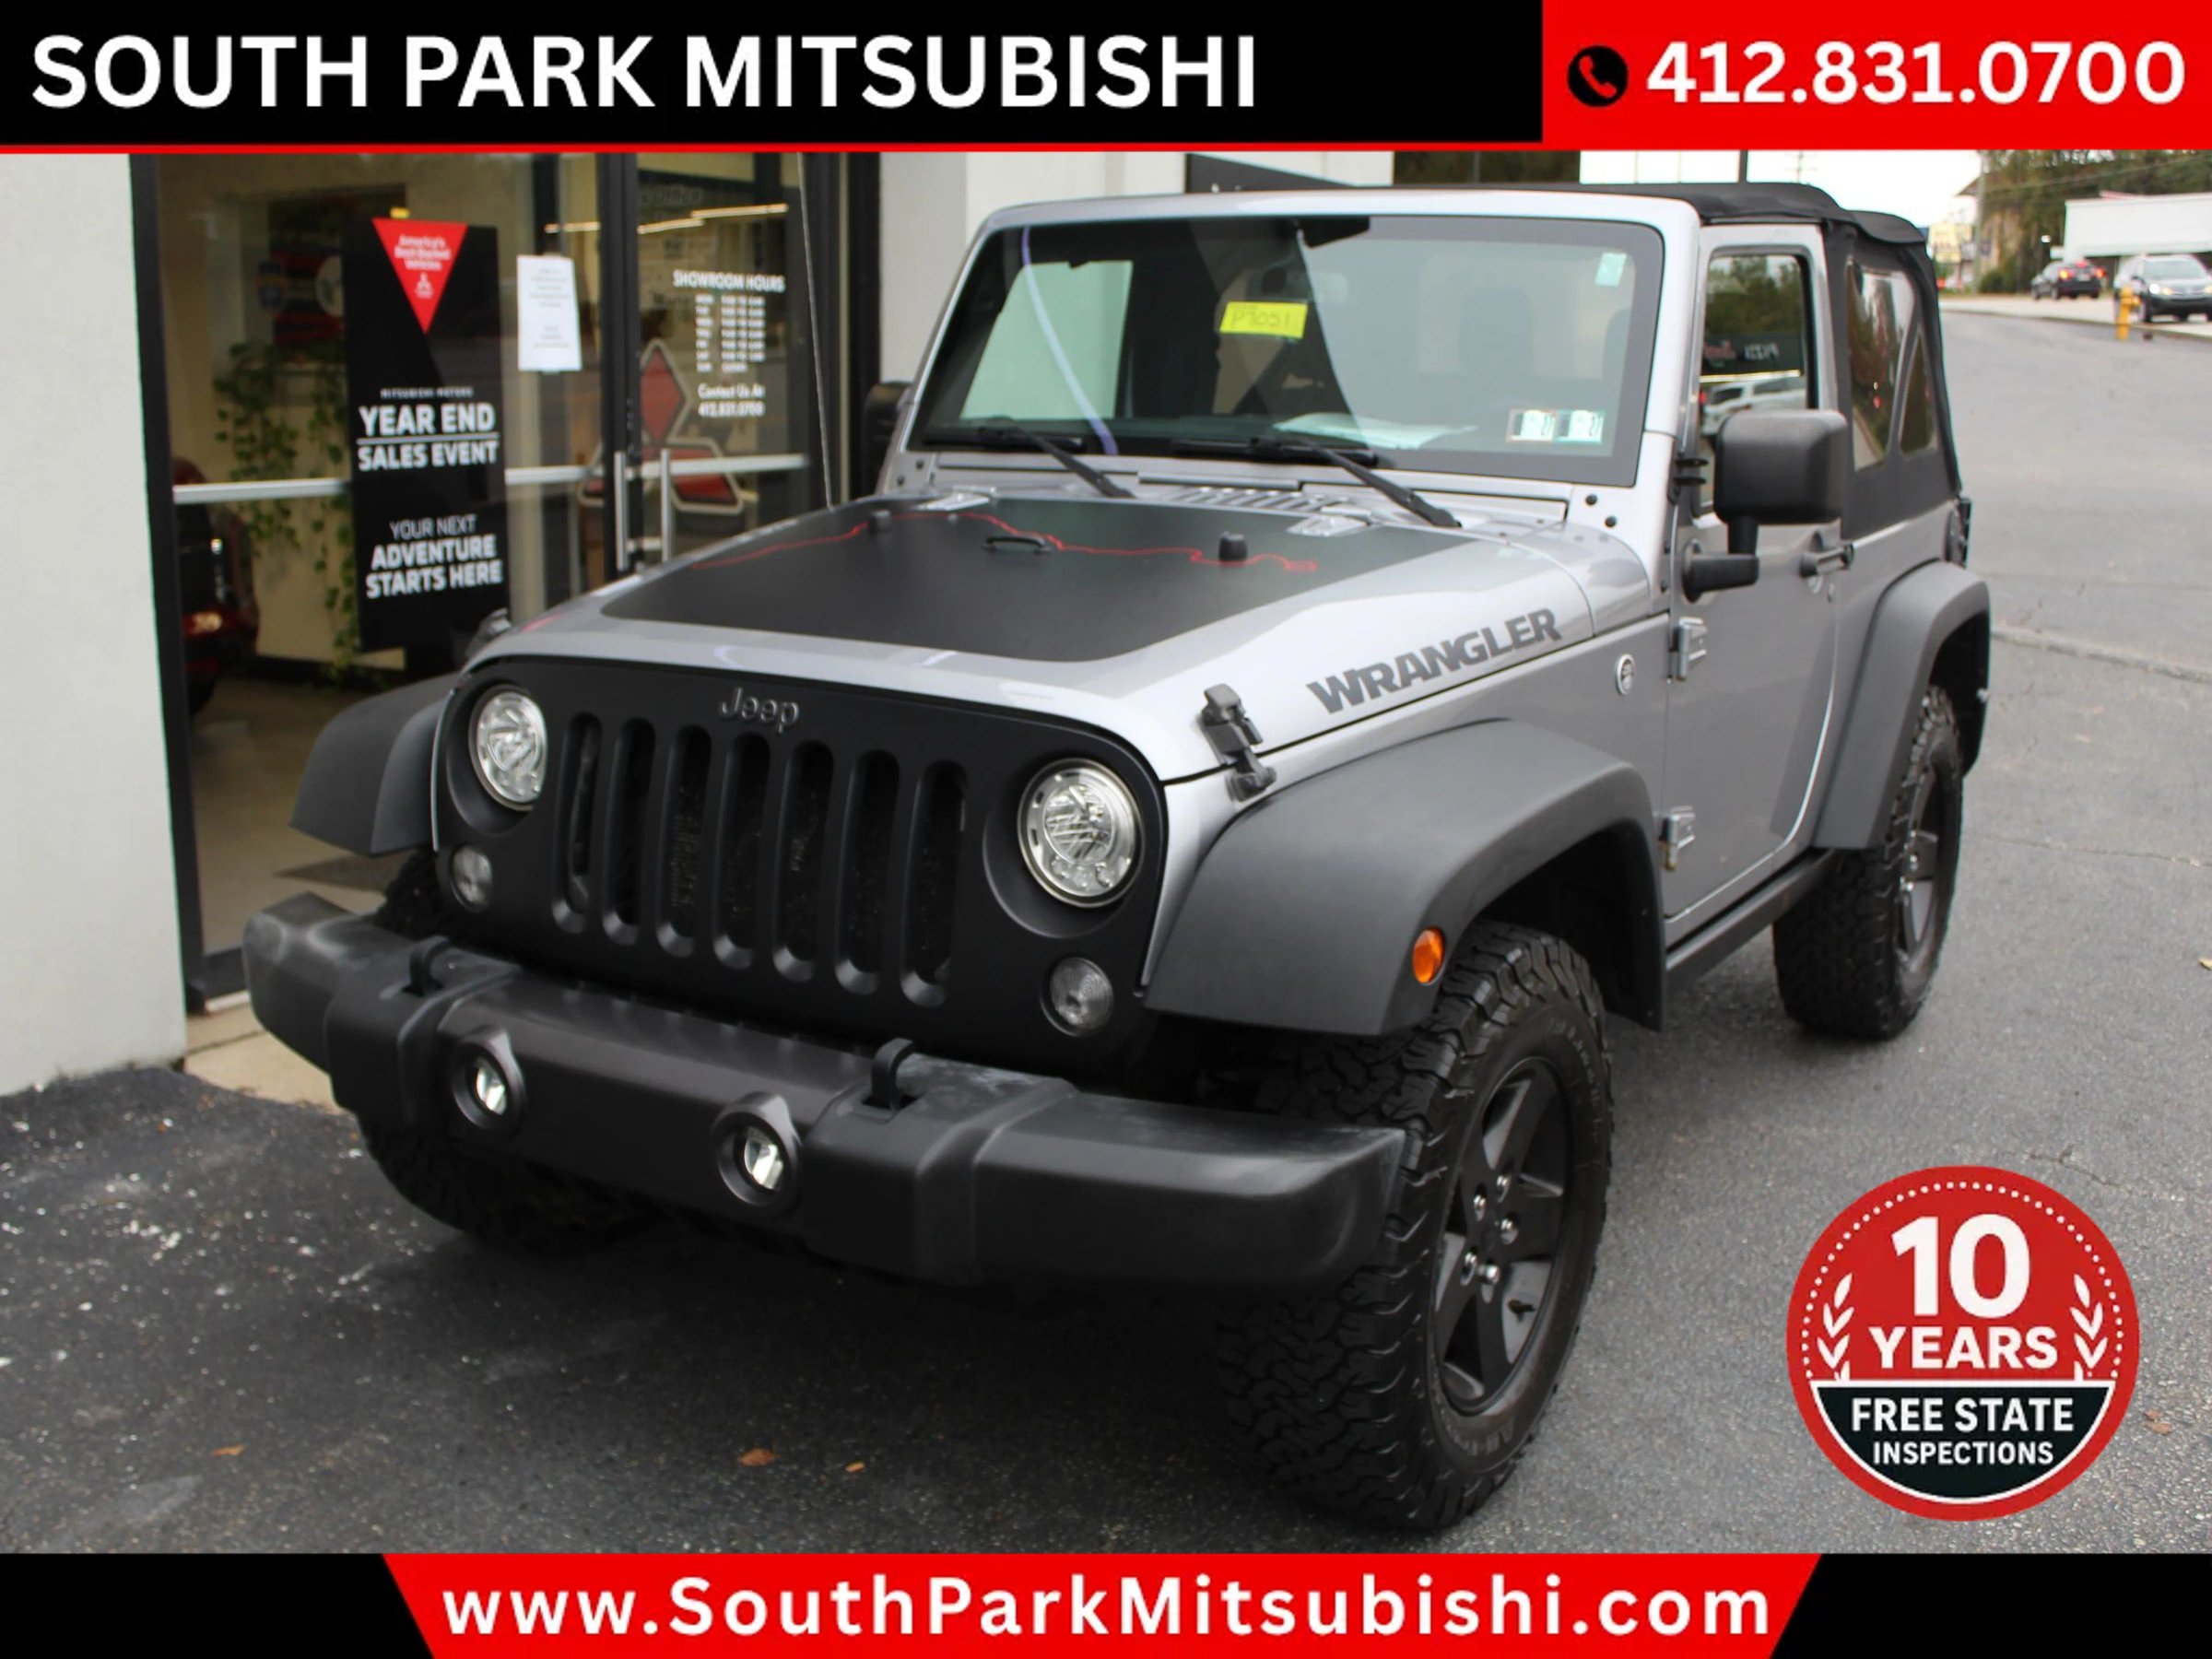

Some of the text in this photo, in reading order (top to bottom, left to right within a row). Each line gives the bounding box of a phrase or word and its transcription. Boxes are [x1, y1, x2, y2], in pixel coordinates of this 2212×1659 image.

[746, 273, 786, 293] HOURS
[358, 402, 497, 437] YEAR END
[357, 440, 500, 472] SALES EVENT
[389, 513, 477, 541] YOUR NEXT
[371, 533, 497, 571] ADVENTURE
[365, 559, 504, 599] STARTS HERE
[1305, 608, 1563, 715] WRANGLER
[719, 686, 800, 734] Jeep
